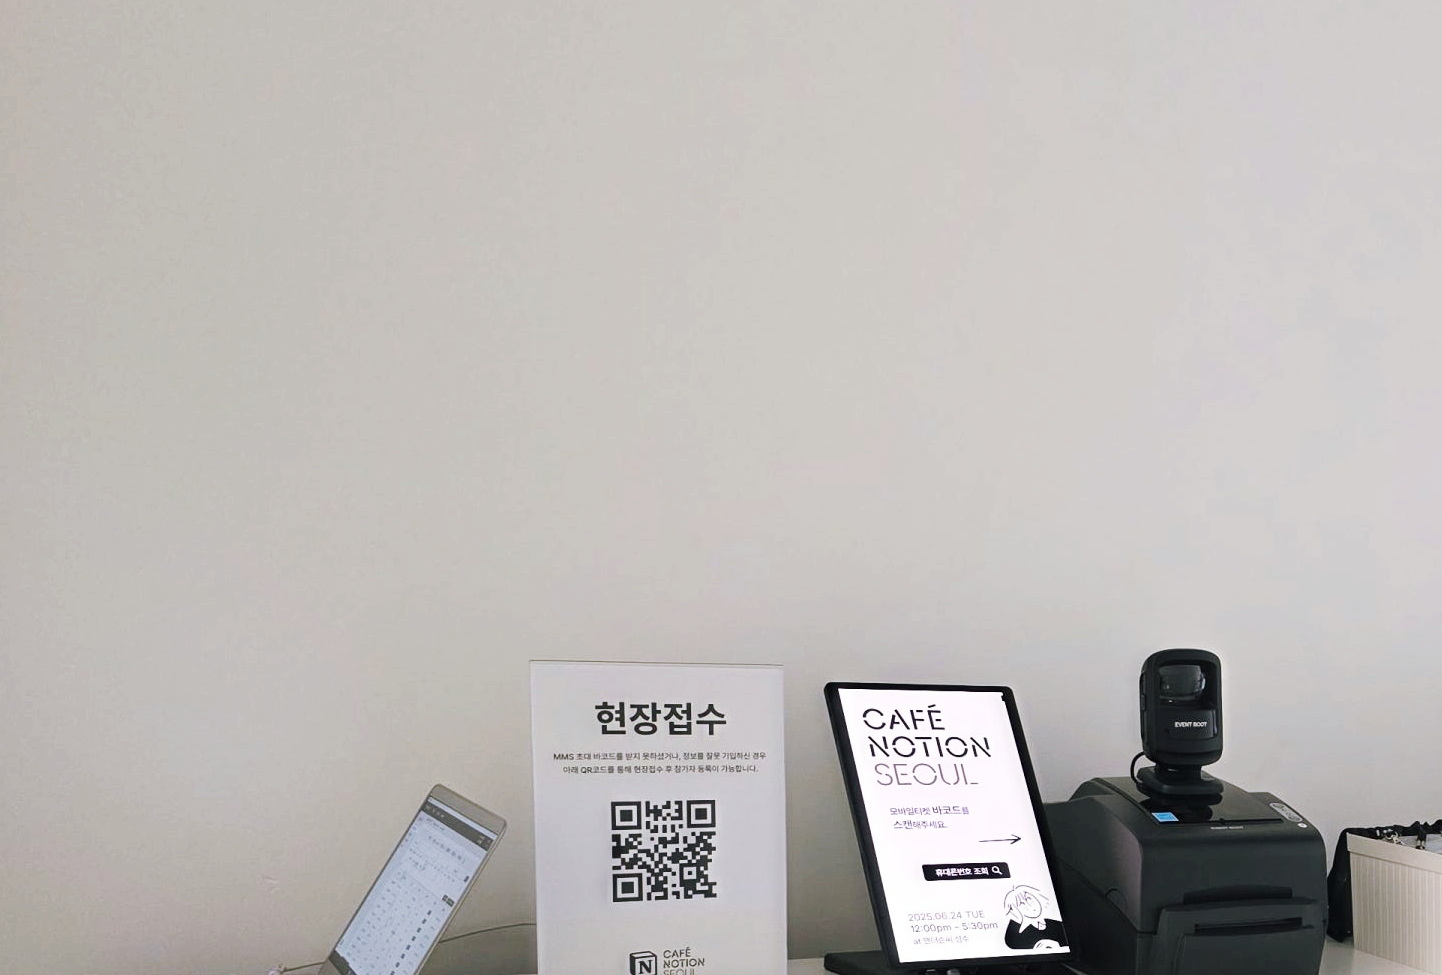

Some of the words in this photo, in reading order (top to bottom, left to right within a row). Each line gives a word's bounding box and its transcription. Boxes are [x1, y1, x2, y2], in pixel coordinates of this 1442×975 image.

[595, 702, 727, 735] 현장접수
[862, 704, 945, 731] CAFÉ
[868, 735, 992, 758] NOTION
[553, 753, 574, 761] MMS
[576, 752, 592, 761] 초대
[593, 752, 623, 761] 바코드를
[625, 752, 641, 761] 받지
[642, 752, 681, 762] 못하셨거나,
[683, 751, 704, 760] 정보를
[722, 751, 751, 760] 기입하신
[752, 751, 767, 760] 경우
[563, 765, 579, 774] 아래
[580, 765, 615, 774] QR코드를
[617, 765, 632, 774] 통해
[633, 765, 663, 774] 현장접수
[698, 764, 719, 774] 등록이
[720, 764, 759, 773] 가능합니다.
[874, 762, 979, 786] SEOUL
[889, 807, 931, 816] 모바일티켓
[932, 805, 970, 815] 바코드를
[907, 911, 962, 922] 2025.06.24
[965, 910, 985, 919] TUE
[910, 923, 952, 933] 12:00pm
[961, 921, 999, 931] 5:30pm
[663, 946, 691, 959] CAFÉ
[663, 958, 705, 969] NOTION
